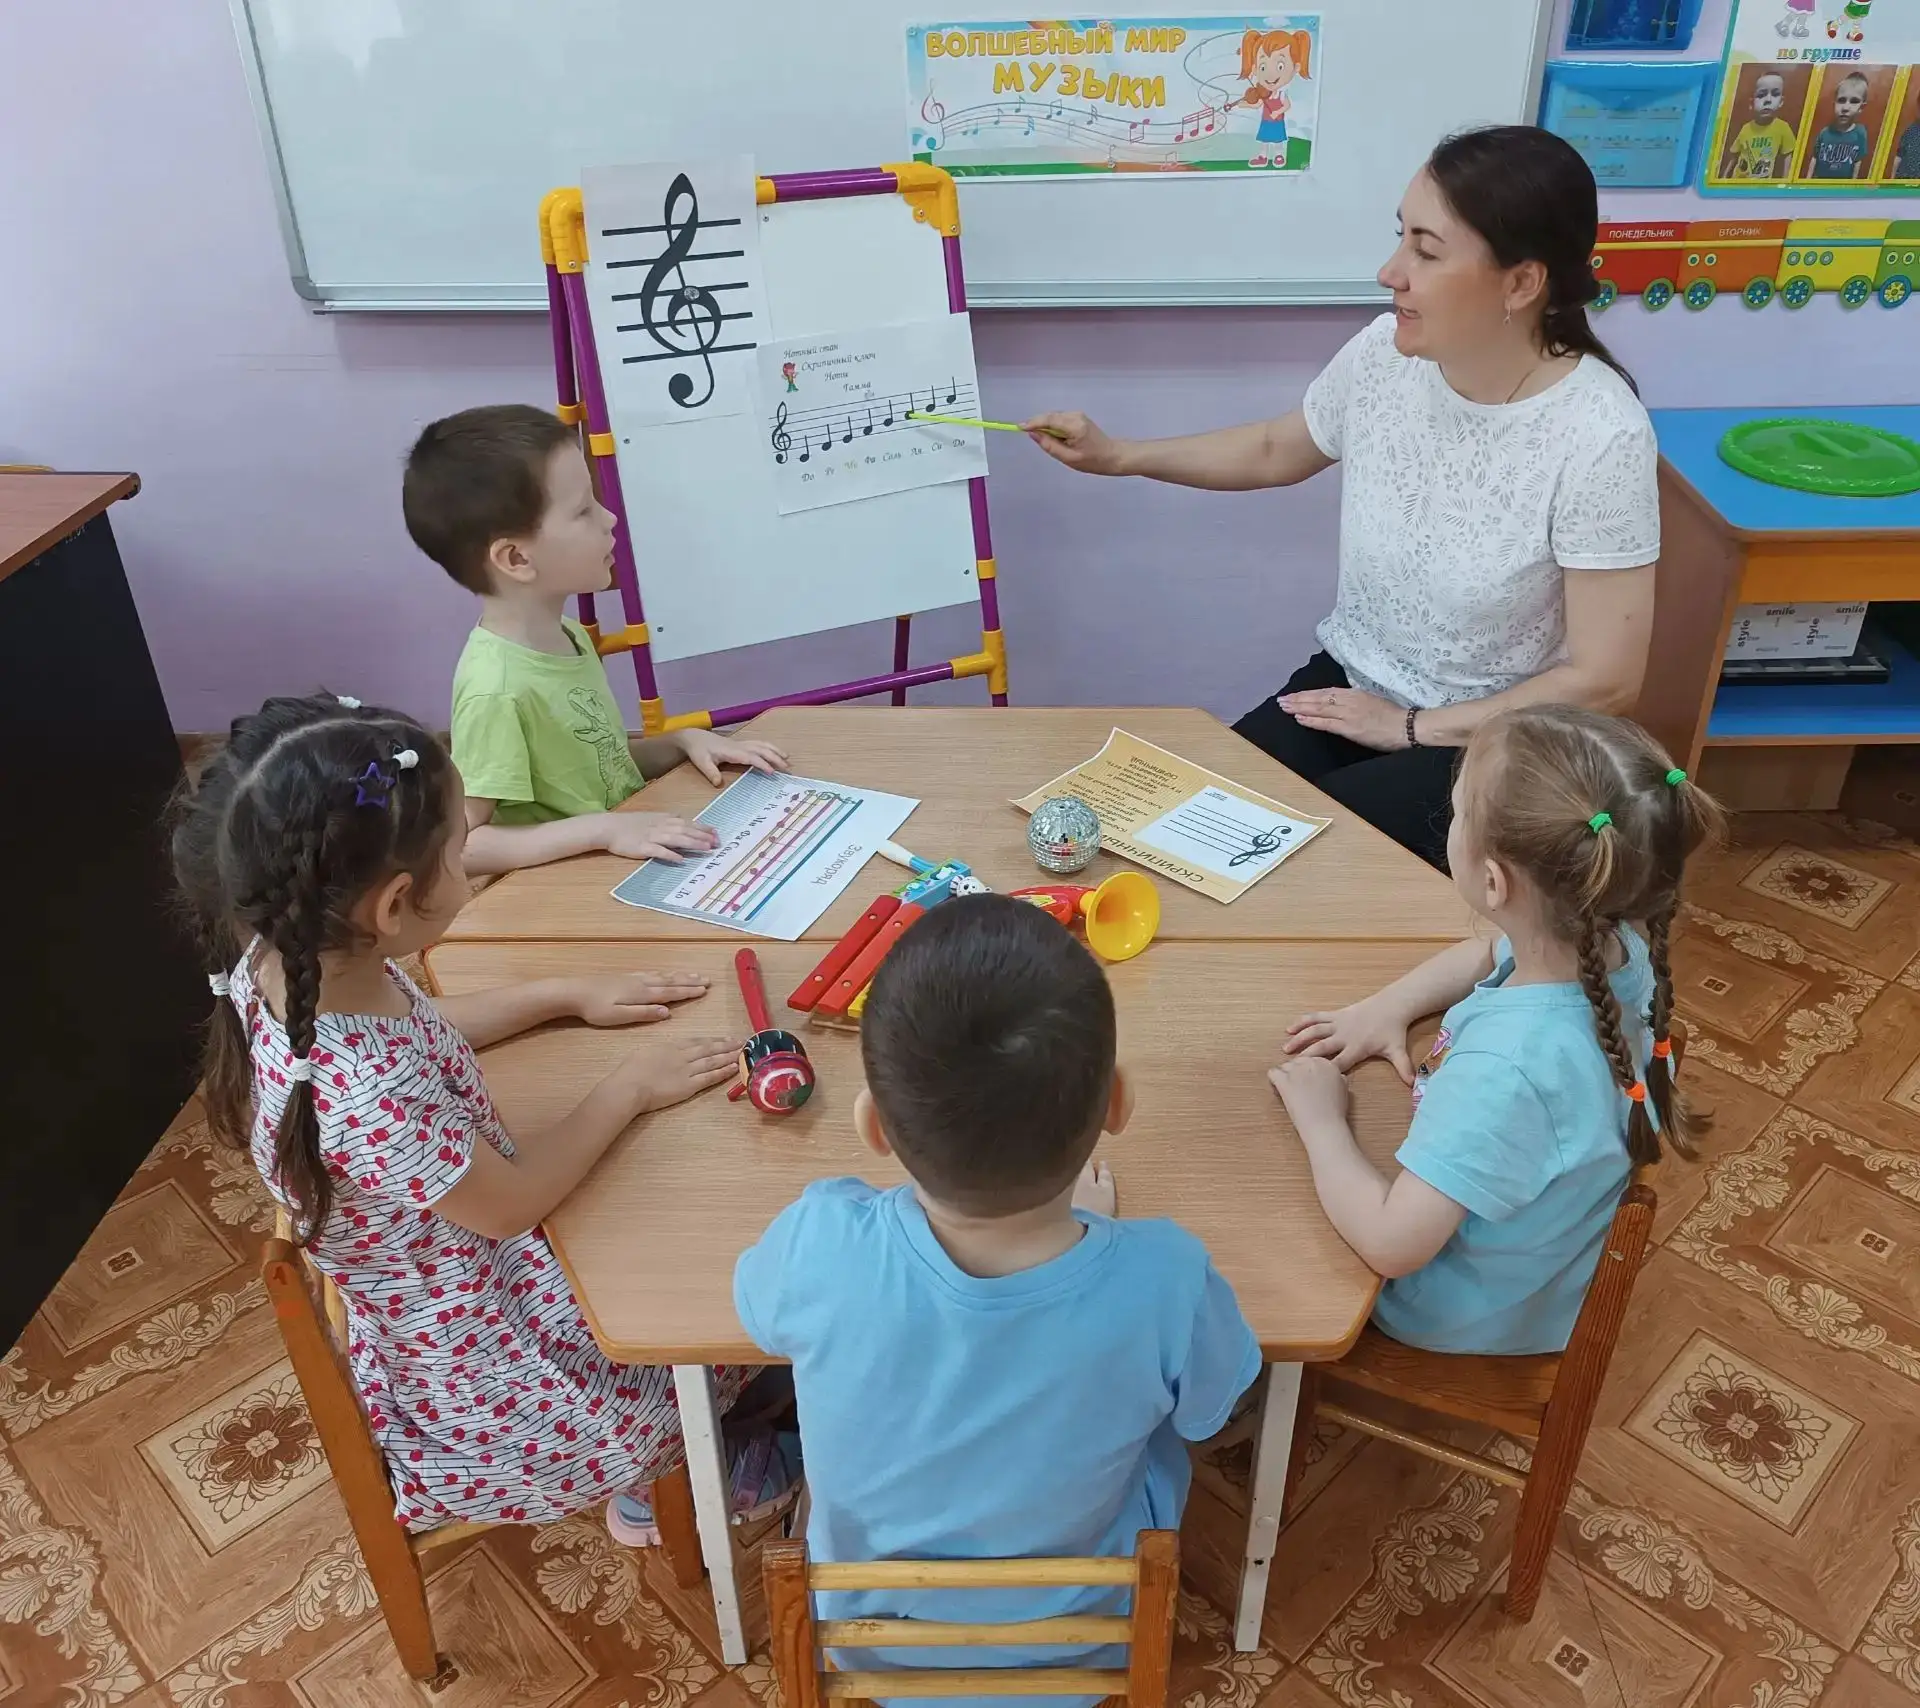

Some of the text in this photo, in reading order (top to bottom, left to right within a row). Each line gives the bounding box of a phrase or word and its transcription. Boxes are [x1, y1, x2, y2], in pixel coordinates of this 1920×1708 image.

[926, 22, 1186, 58] ВОЛШЕБНЫЙ МИР
[1776, 47, 1861, 62] по группе
[993, 61, 1166, 108] МУЗЫКИ
[1609, 228, 1675, 240] ПОНЕДЕЛЬНИК
[1719, 226, 1761, 237] ВТОРНИК
[784, 346, 817, 359] Нотный
[801, 352, 876, 371] Скрипичный ключ
[843, 381, 871, 392] Гамма
[811, 843, 863, 887] Звукоряд
